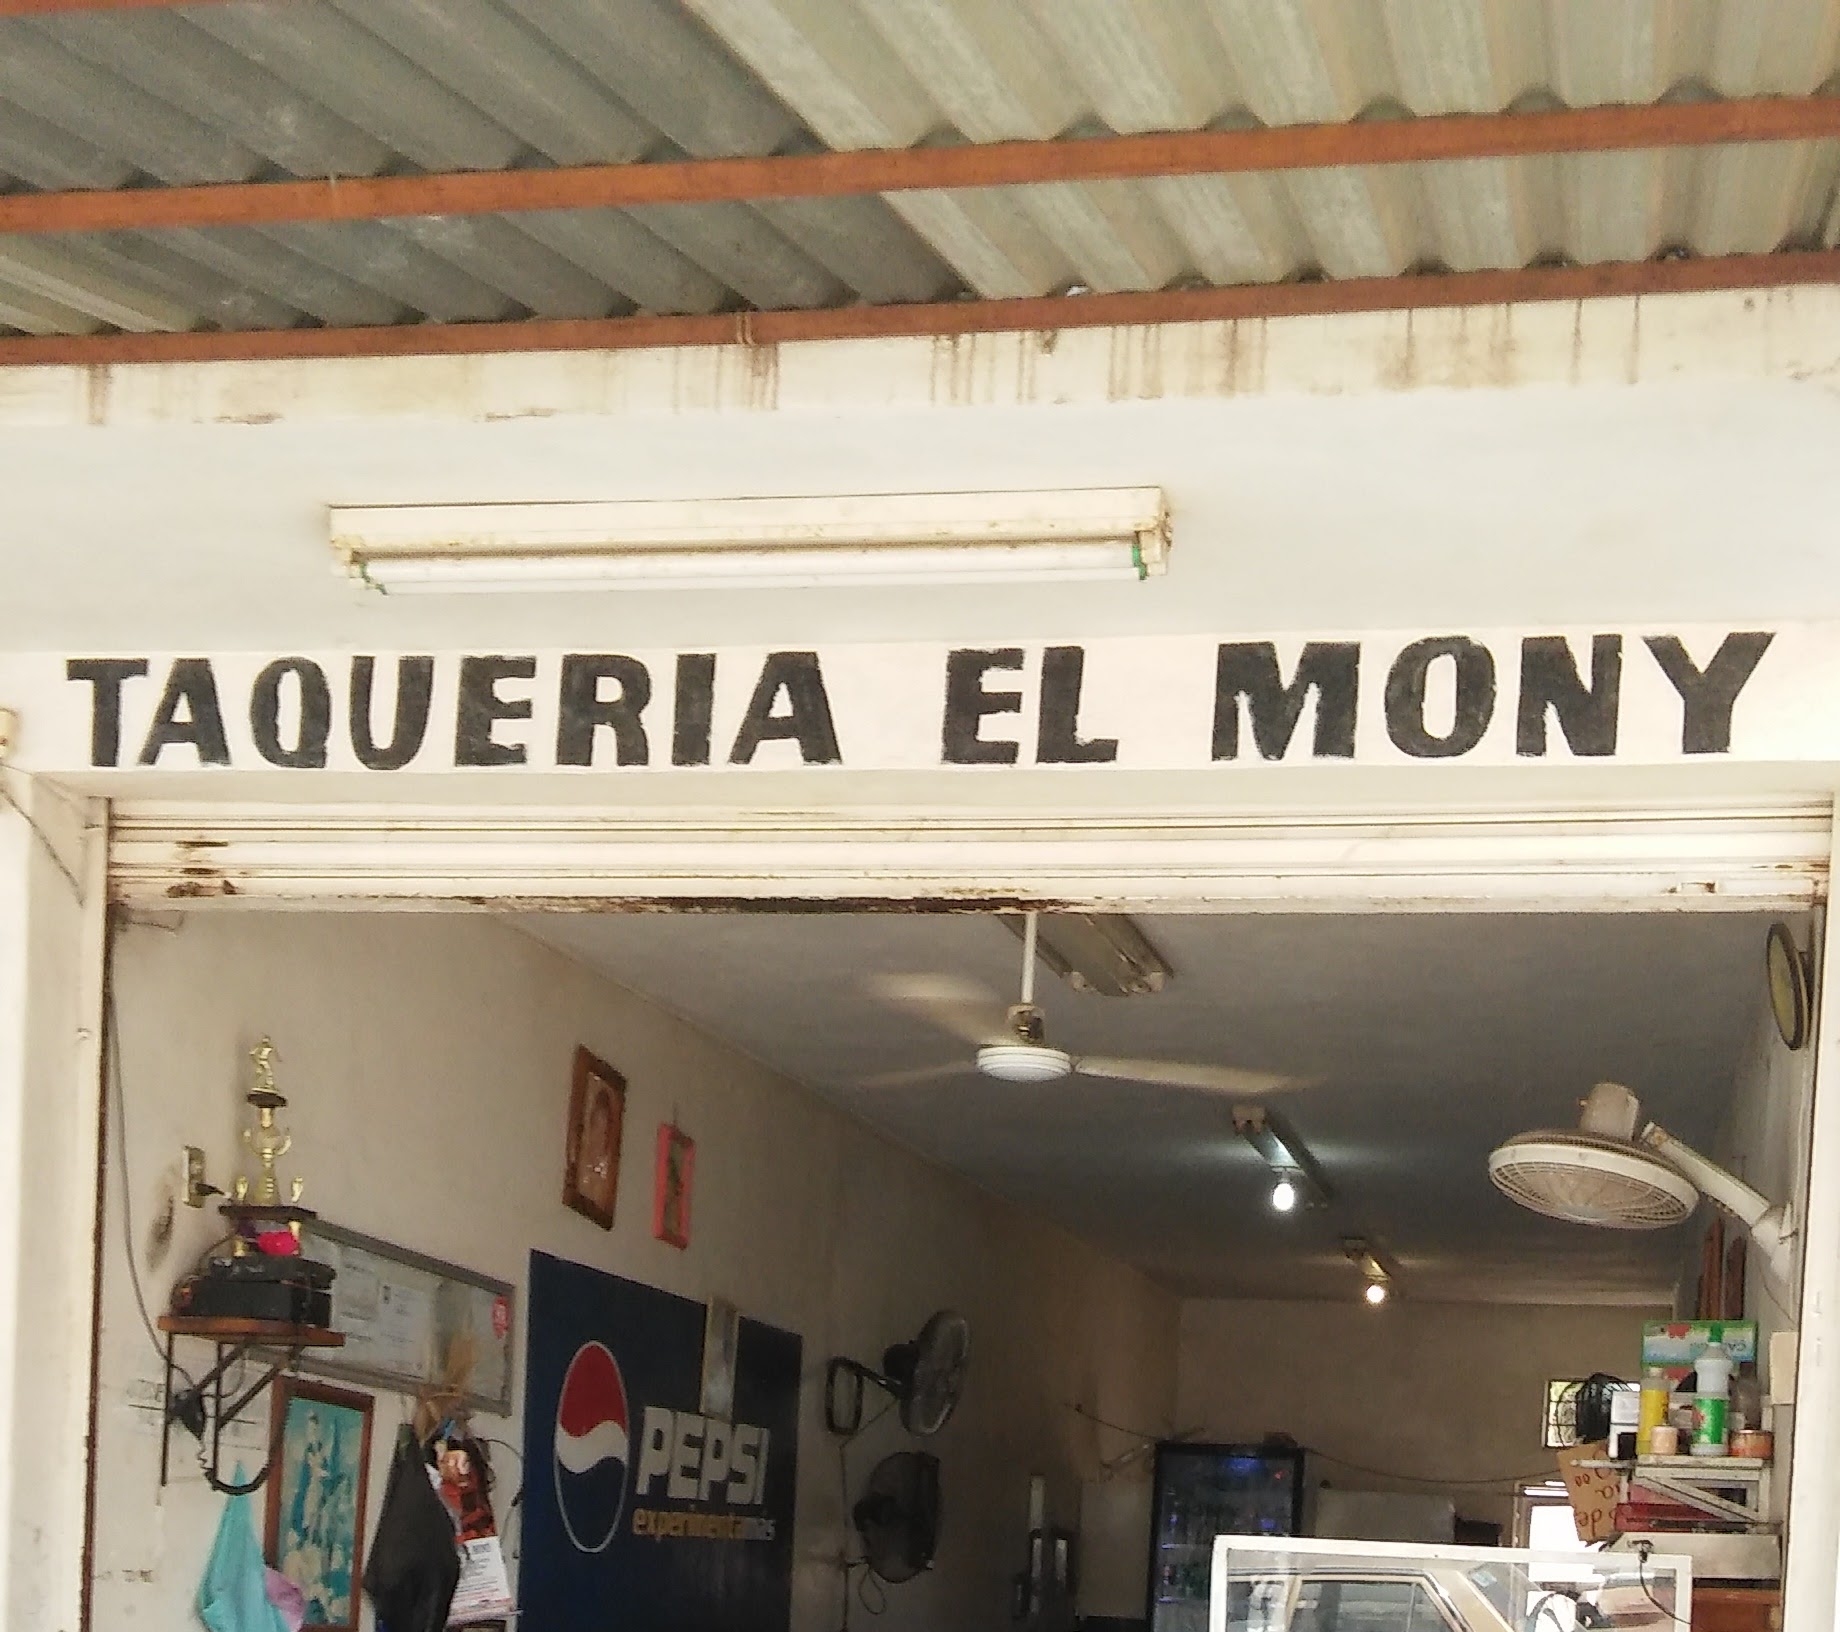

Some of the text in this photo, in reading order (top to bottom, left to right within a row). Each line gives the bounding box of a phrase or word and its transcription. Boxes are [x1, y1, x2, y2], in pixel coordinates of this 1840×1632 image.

[66, 631, 1776, 770] TAQUERIA EL MONY
[635, 1405, 771, 1505] PEPSI
